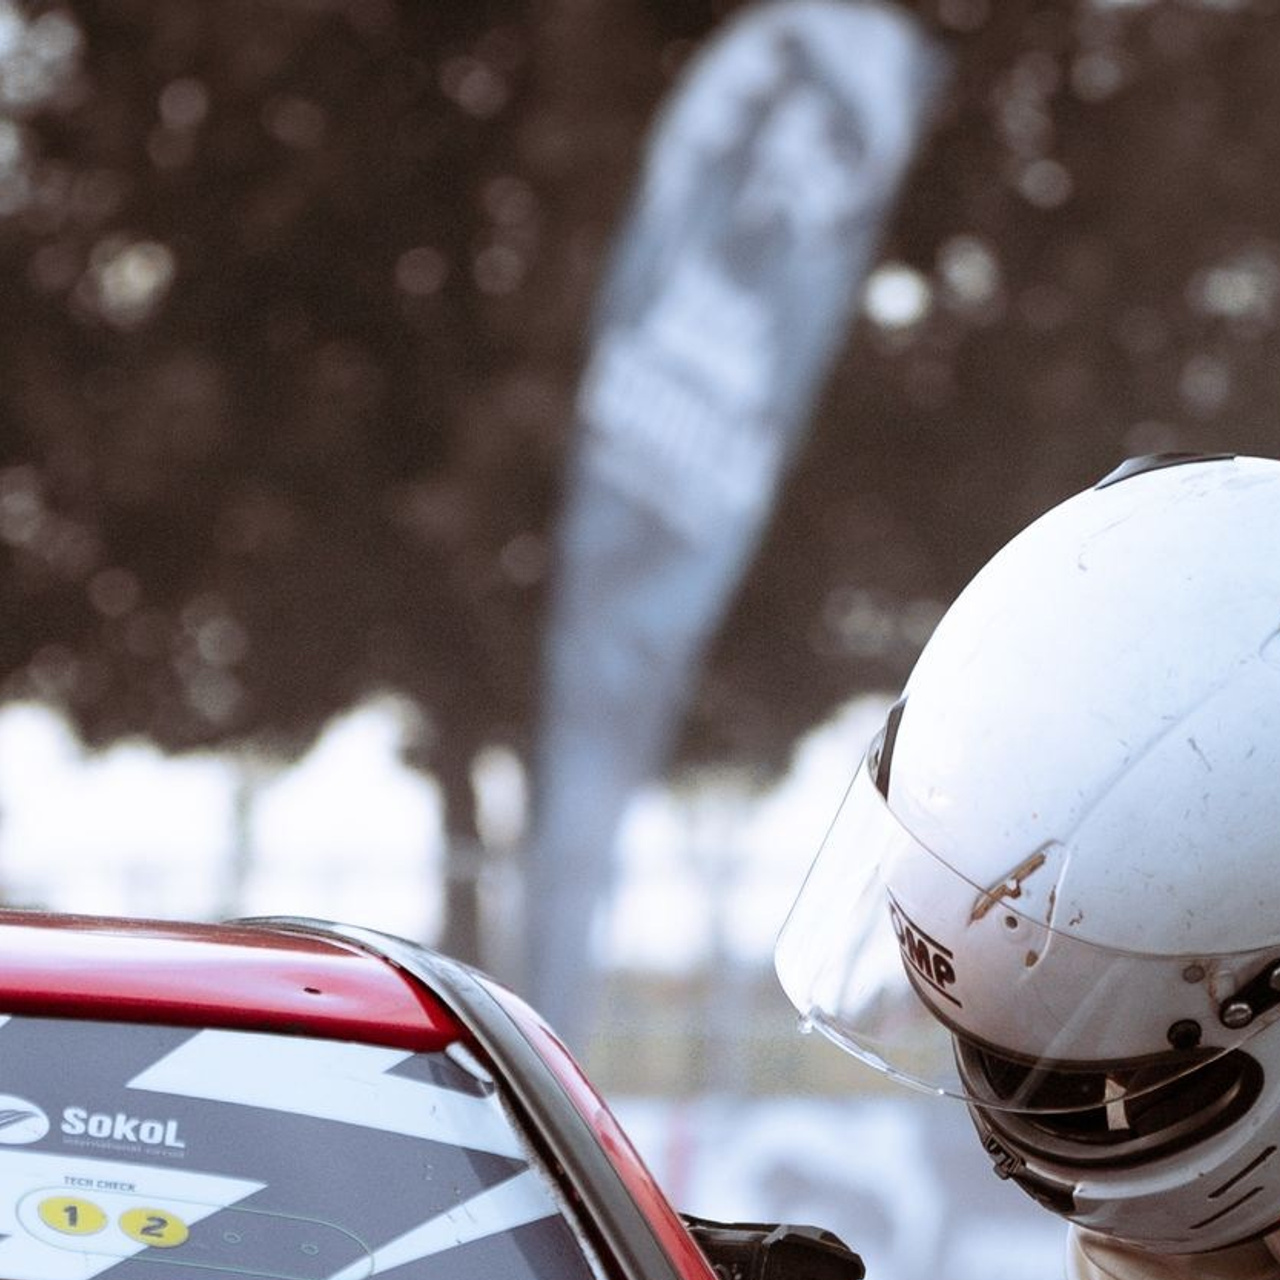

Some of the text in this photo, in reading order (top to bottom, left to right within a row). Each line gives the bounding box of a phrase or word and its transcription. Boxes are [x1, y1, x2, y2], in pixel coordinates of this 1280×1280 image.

[64, 1176, 136, 1192] TECH CHECK
[63, 1205, 168, 1238] 1 2
